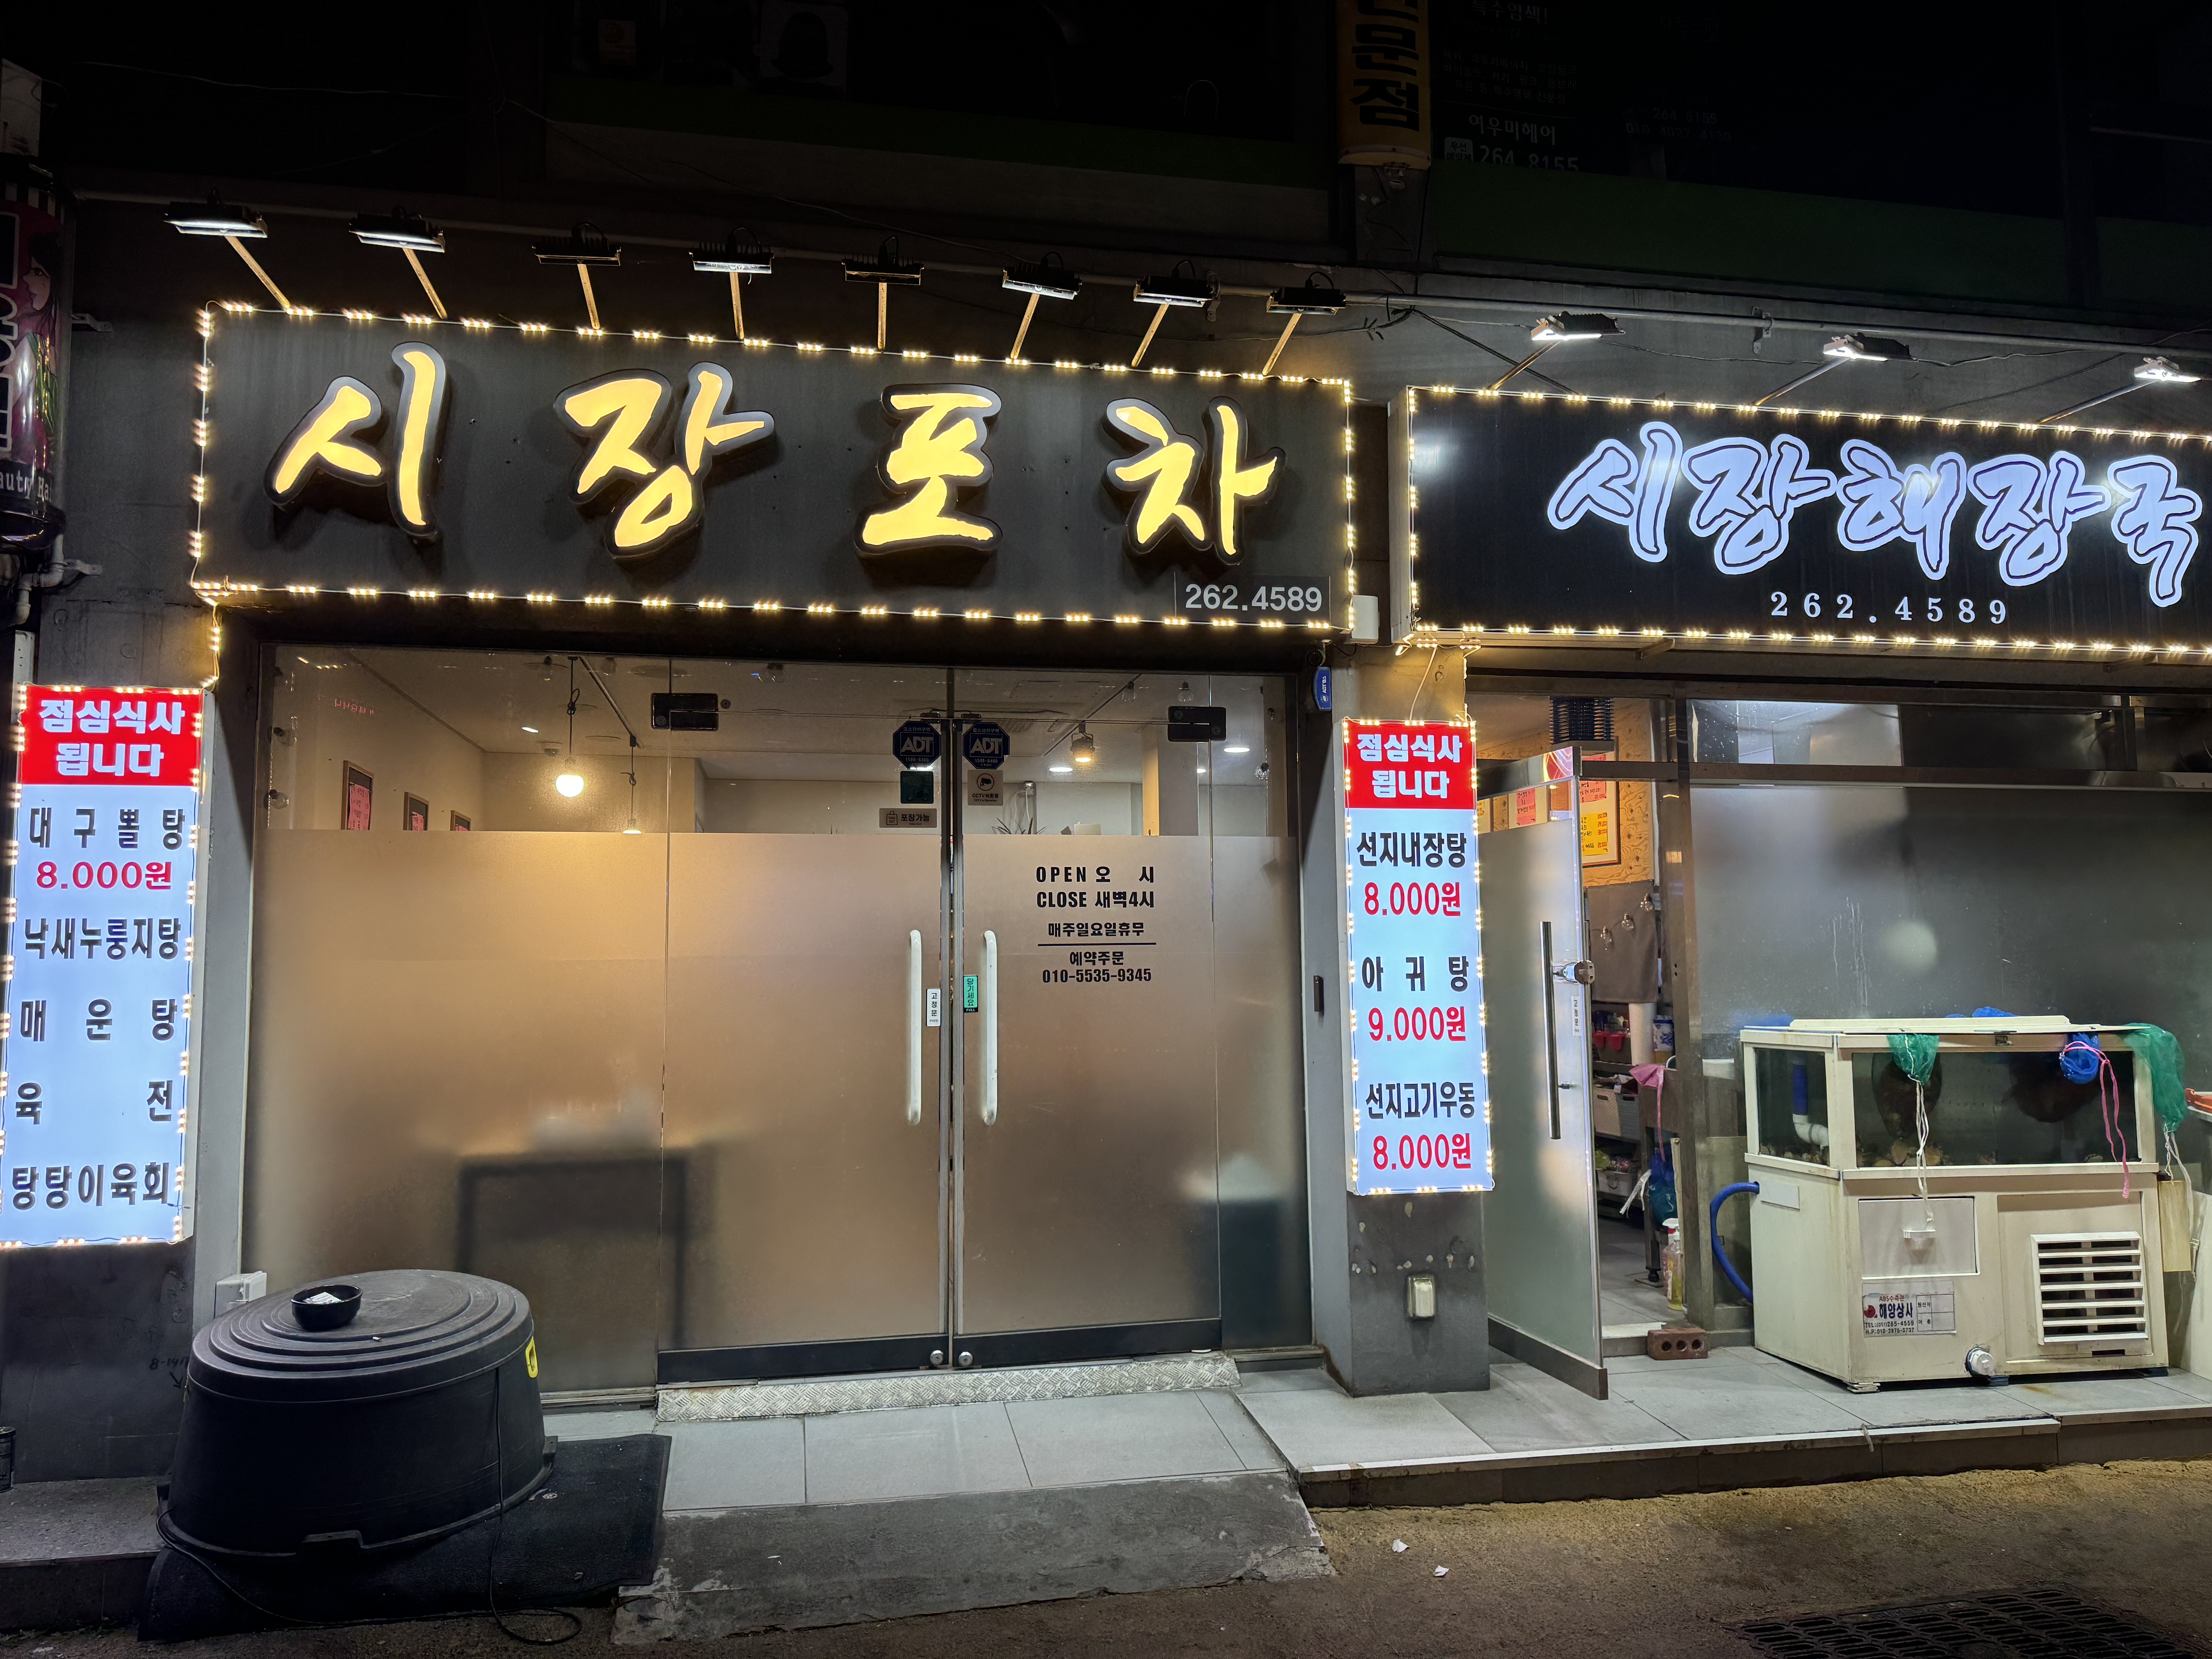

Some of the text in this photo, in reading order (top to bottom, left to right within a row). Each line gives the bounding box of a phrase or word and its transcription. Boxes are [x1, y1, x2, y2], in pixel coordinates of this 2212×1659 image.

[1469, 115, 1555, 146] 여우미헤어
[1185, 583, 1323, 613] 262.4589
[1770, 591, 2008, 625] 262.4589
[40, 699, 185, 734] 점심식사
[56, 743, 164, 776] 됩니다
[901, 736, 934, 753] ADT
[970, 738, 1002, 754] ADT
[1357, 734, 1462, 763] 점심식사
[1372, 770, 1449, 798] 됩니다
[1357, 832, 1467, 868] 선지내장탕
[37, 862, 171, 890] 8.000원
[1036, 866, 1086, 882] OPEN
[1037, 891, 1154, 908] CLOSE 새벽4시
[1365, 882, 1461, 916] 8.000원
[25, 918, 181, 959] 낙새누룽지탕
[1048, 922, 1144, 937] 매주일요일휴무
[1070, 951, 1124, 965] 예약주문
[1042, 969, 1152, 983] 010-5535-9345
[1369, 1006, 1466, 1042] 9.000원
[1366, 1082, 1475, 1119] 선지고기우동
[1373, 1133, 1472, 1170] 8.000원
[12, 1162, 169, 1210] 탕탕이육회
[1879, 1302, 1913, 1319] 해양상사
